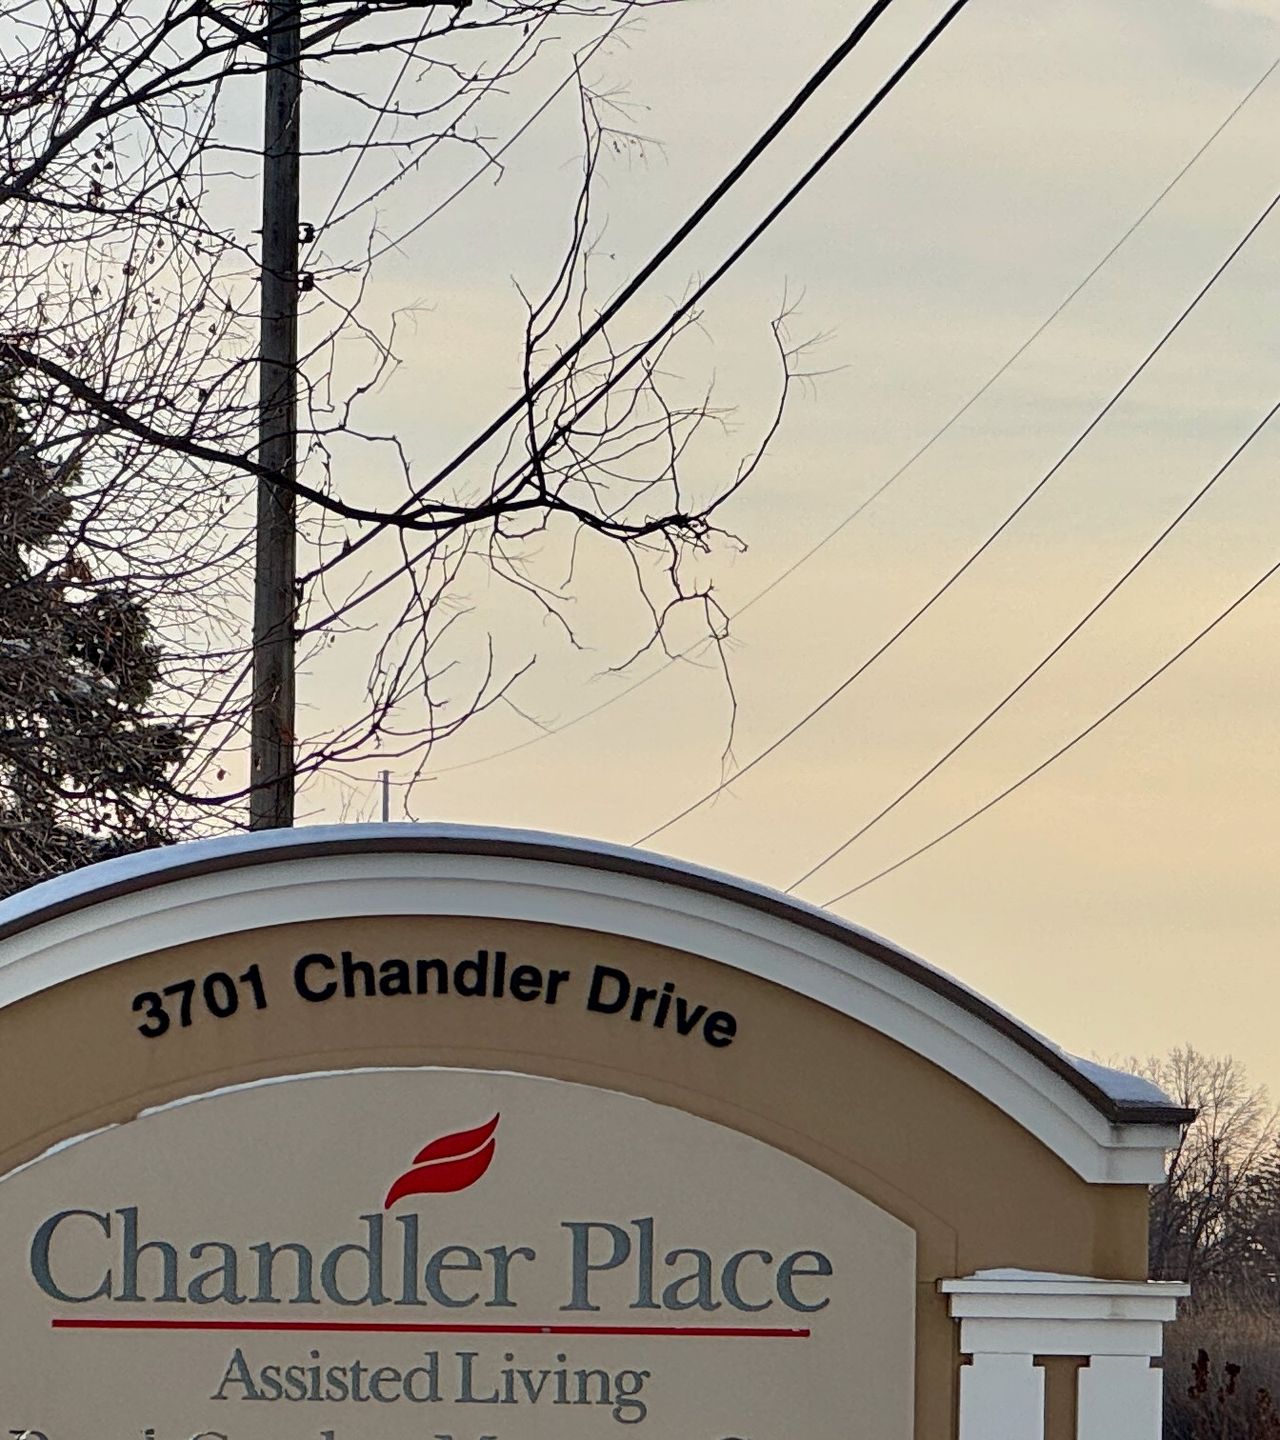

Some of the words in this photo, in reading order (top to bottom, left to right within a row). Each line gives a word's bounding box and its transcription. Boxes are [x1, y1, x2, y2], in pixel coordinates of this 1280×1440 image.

[132, 964, 268, 1039] 3701
[293, 950, 571, 1005] Chandler
[586, 964, 738, 1048] Drive
[29, 1206, 537, 1308] Chandler
[558, 1217, 833, 1313] Place
[210, 1347, 444, 1402] Assisted
[454, 1351, 651, 1424] Living
